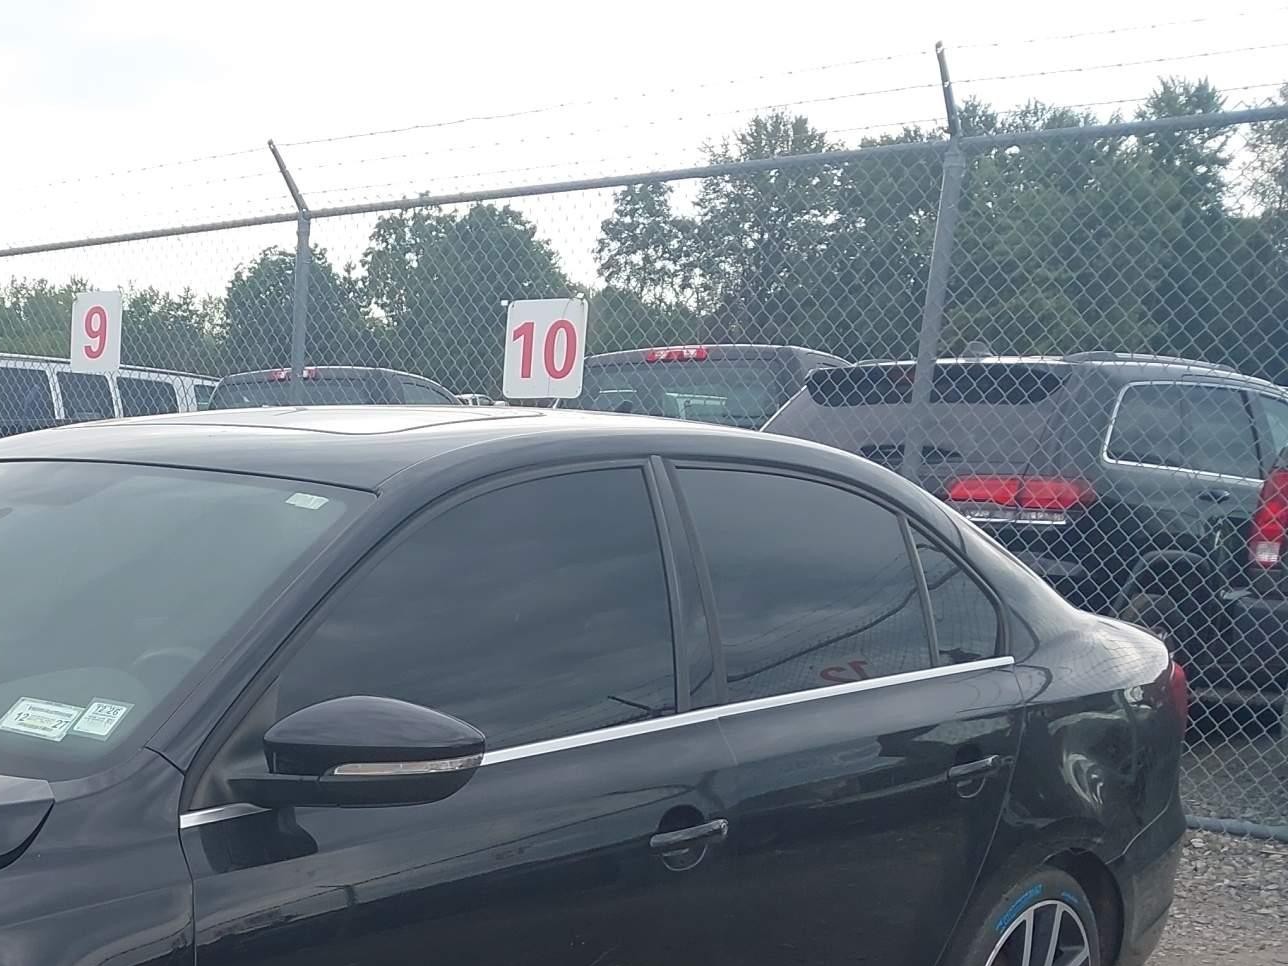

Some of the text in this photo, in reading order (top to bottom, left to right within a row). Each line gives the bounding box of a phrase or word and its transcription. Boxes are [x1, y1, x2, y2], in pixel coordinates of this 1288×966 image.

[84, 306, 107, 359] 9
[512, 319, 577, 379] 10
[14, 711, 29, 722] 12
